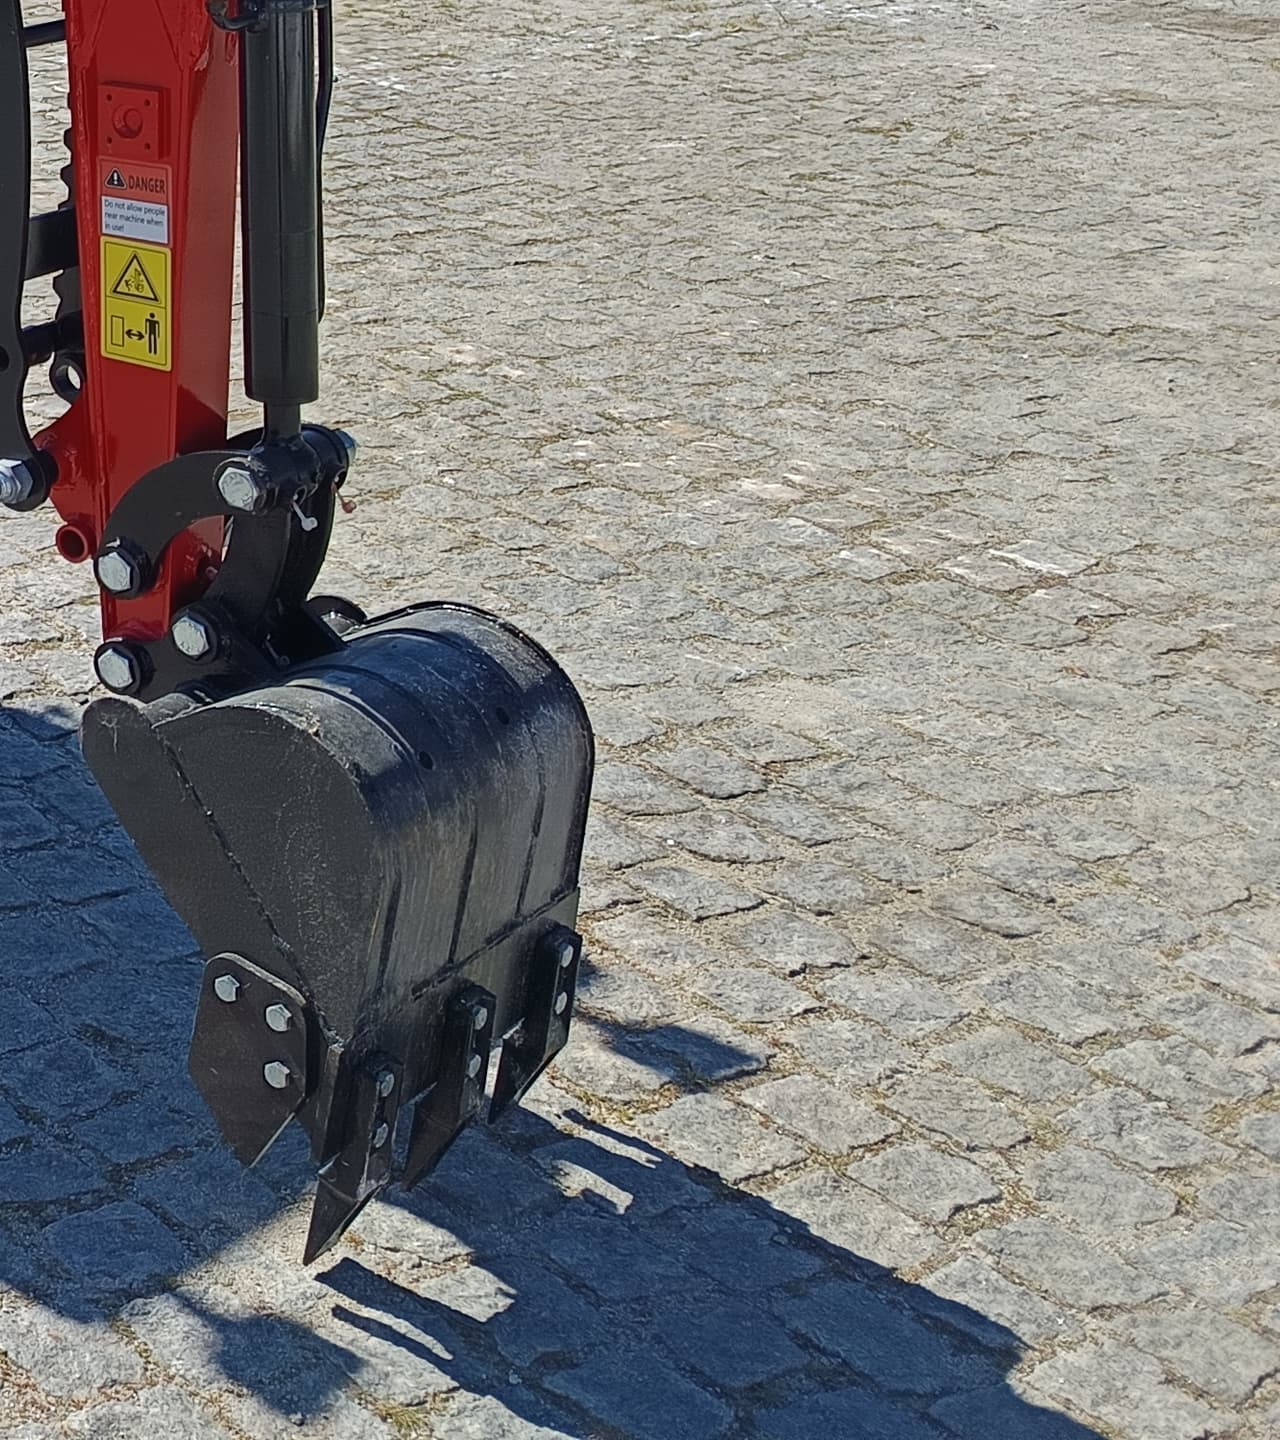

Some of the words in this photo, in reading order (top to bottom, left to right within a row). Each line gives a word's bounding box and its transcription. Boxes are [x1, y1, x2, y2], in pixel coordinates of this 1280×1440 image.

[128, 175, 166, 194] DANGER
[104, 199, 113, 207] Do
[127, 203, 142, 211] allow
[143, 207, 166, 216] people
[118, 213, 145, 224] machine
[146, 217, 163, 226] when
